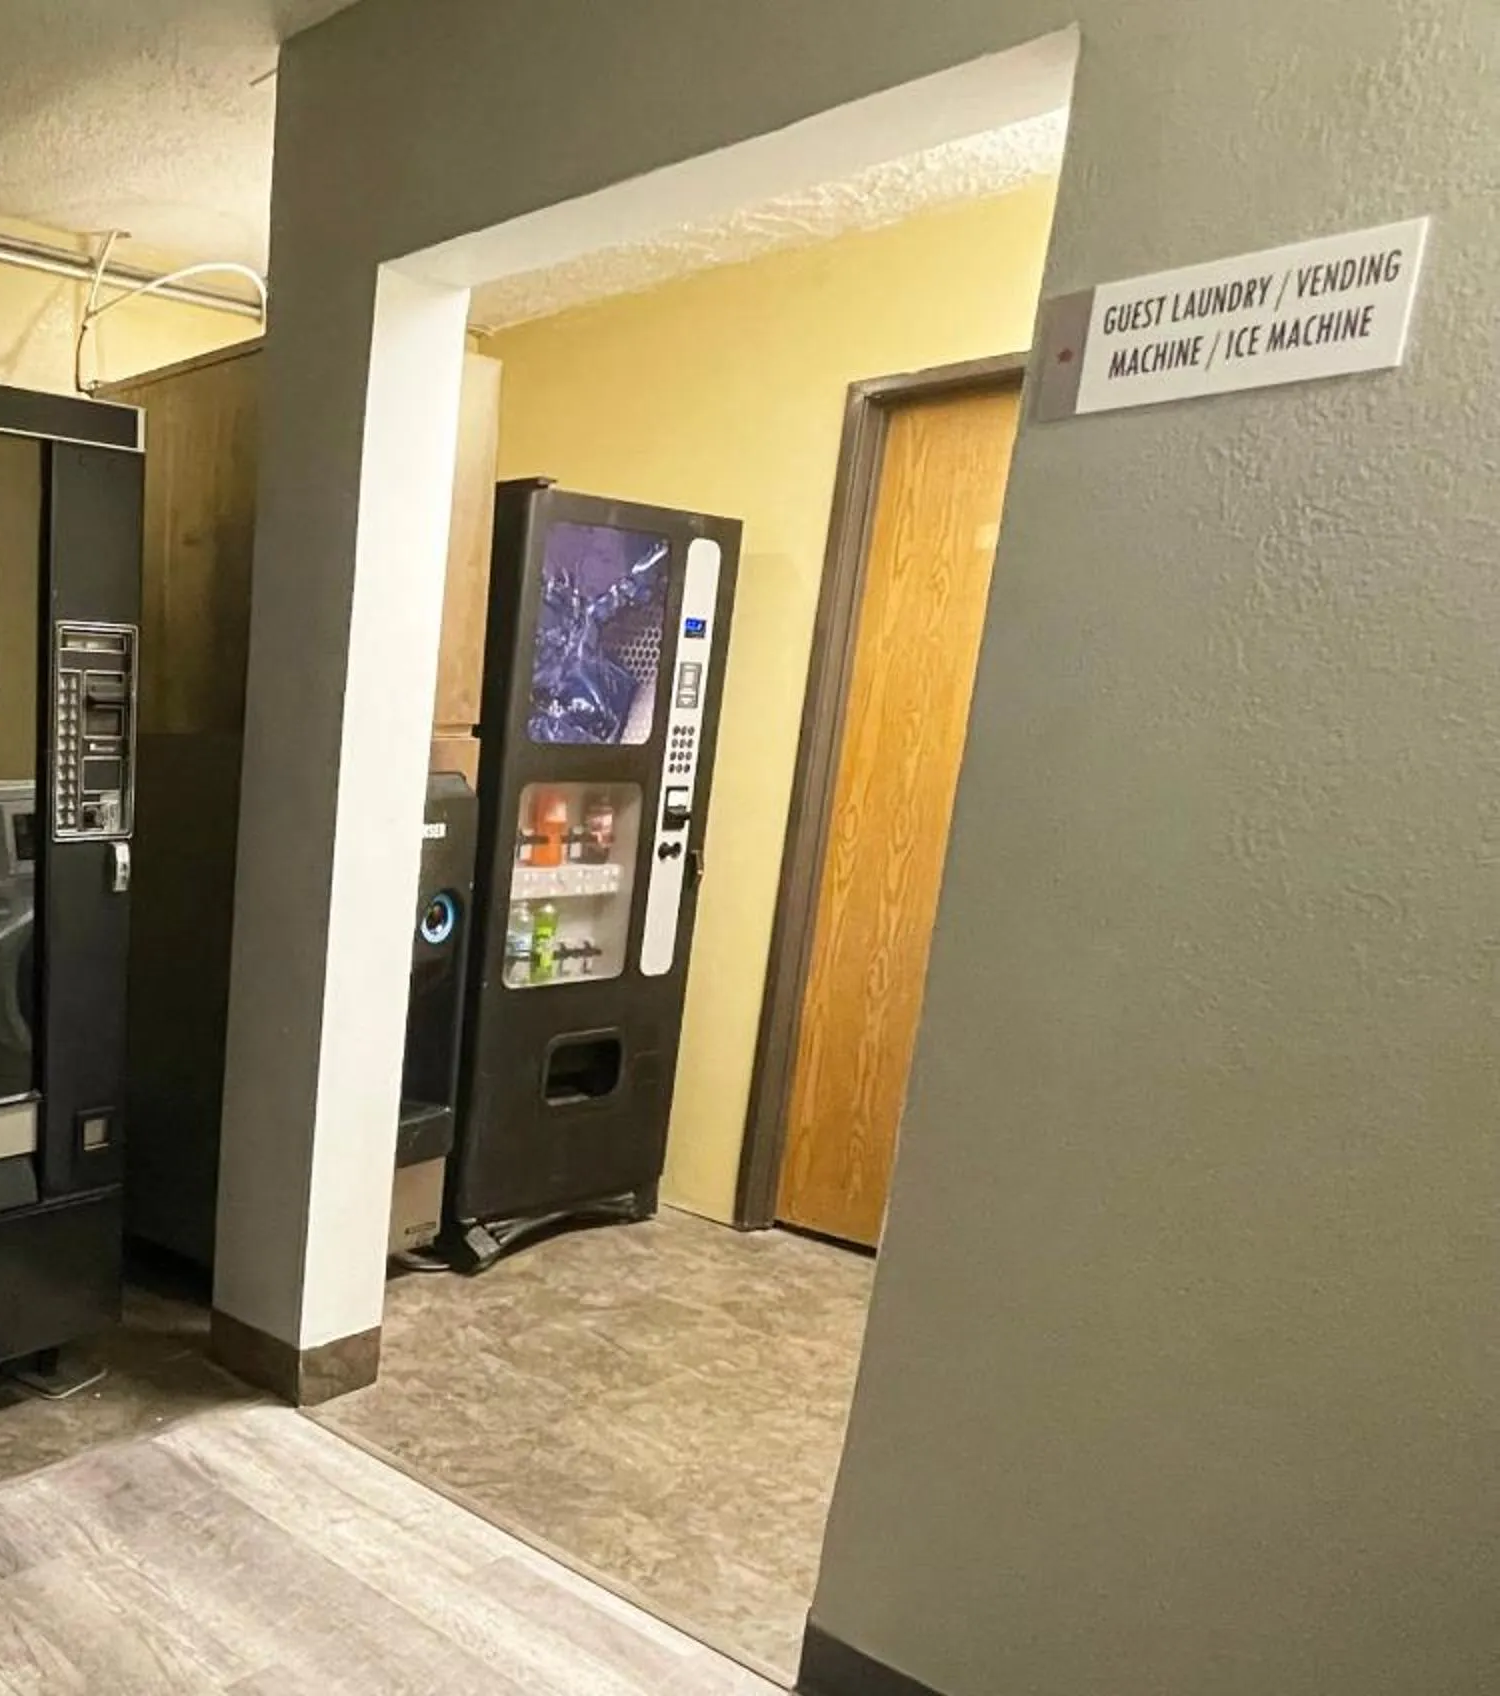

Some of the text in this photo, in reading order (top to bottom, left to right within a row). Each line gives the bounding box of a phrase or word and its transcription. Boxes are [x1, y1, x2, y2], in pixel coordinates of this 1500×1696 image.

[1103, 249, 1402, 335] GUEST LAUNDRY / VENDING
[1108, 304, 1375, 380] MACHINE / ICE MACHINE
